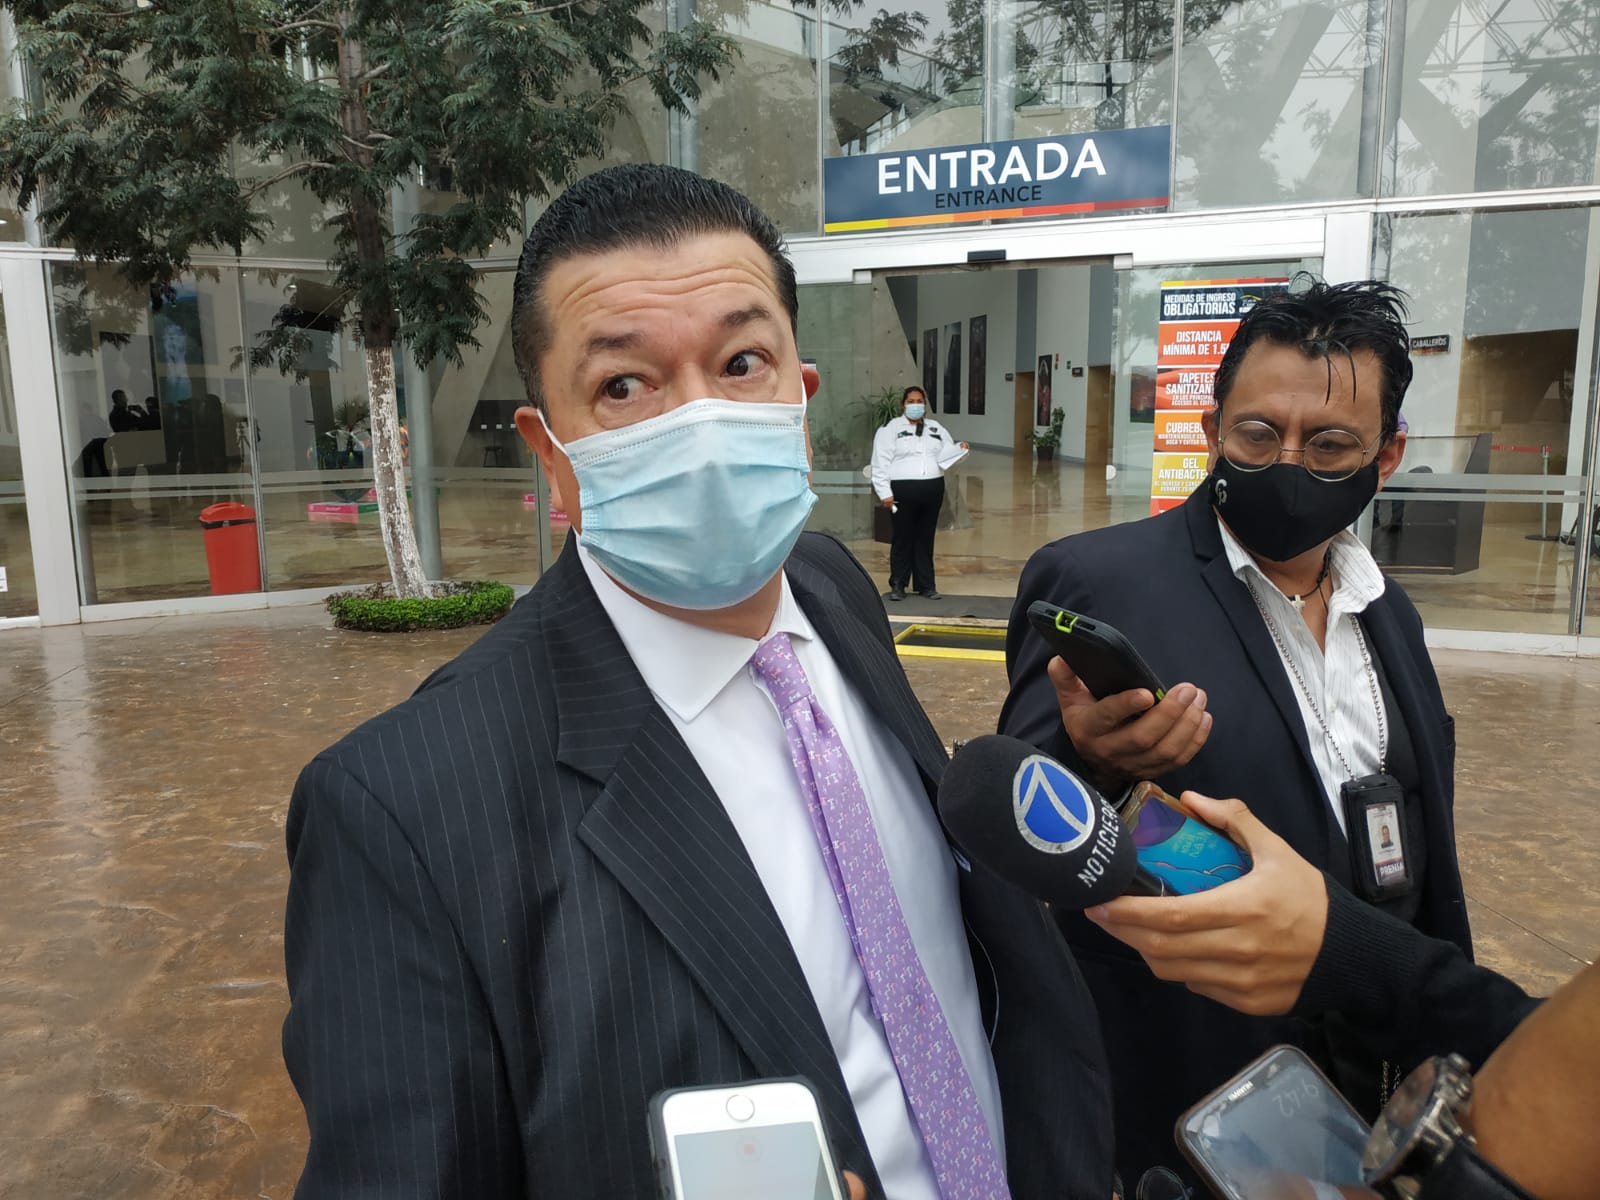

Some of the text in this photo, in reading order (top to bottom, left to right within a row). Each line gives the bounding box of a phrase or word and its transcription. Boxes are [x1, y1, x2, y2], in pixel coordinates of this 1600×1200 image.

[878, 138, 1107, 195] ENTRADA
[935, 184, 1042, 209] ENTRANCE
[1163, 302, 1236, 316] OBLIGATORIAS
[1176, 330, 1222, 343] DISTANCIA
[1412, 337, 1447, 348] CABALLEROS
[1163, 343, 1230, 356] MÍNIMA DE 1.5
[1178, 372, 1215, 383] TAPETES
[1183, 457, 1198, 468] GEL
